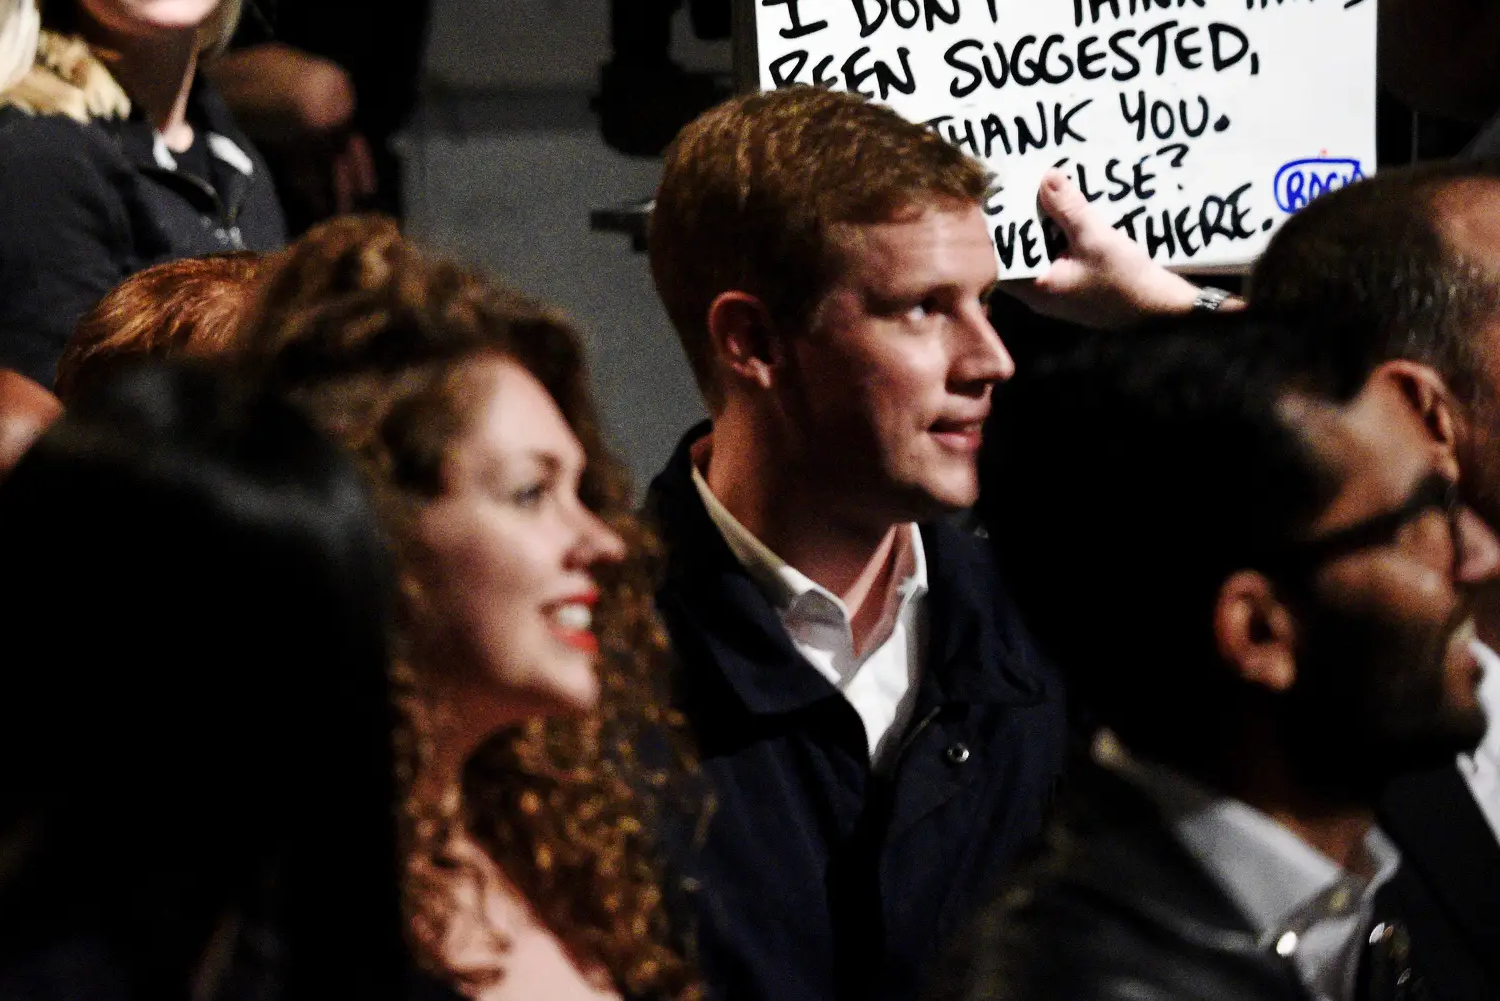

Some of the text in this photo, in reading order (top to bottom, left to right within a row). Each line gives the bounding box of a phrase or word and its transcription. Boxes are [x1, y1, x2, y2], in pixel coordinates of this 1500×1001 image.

[943, 20, 1260, 98] SUGGESTED,
[1119, 90, 1230, 141] YOU.
[1052, 143, 1190, 203] LSE?
[1111, 183, 1274, 259] THERE.
